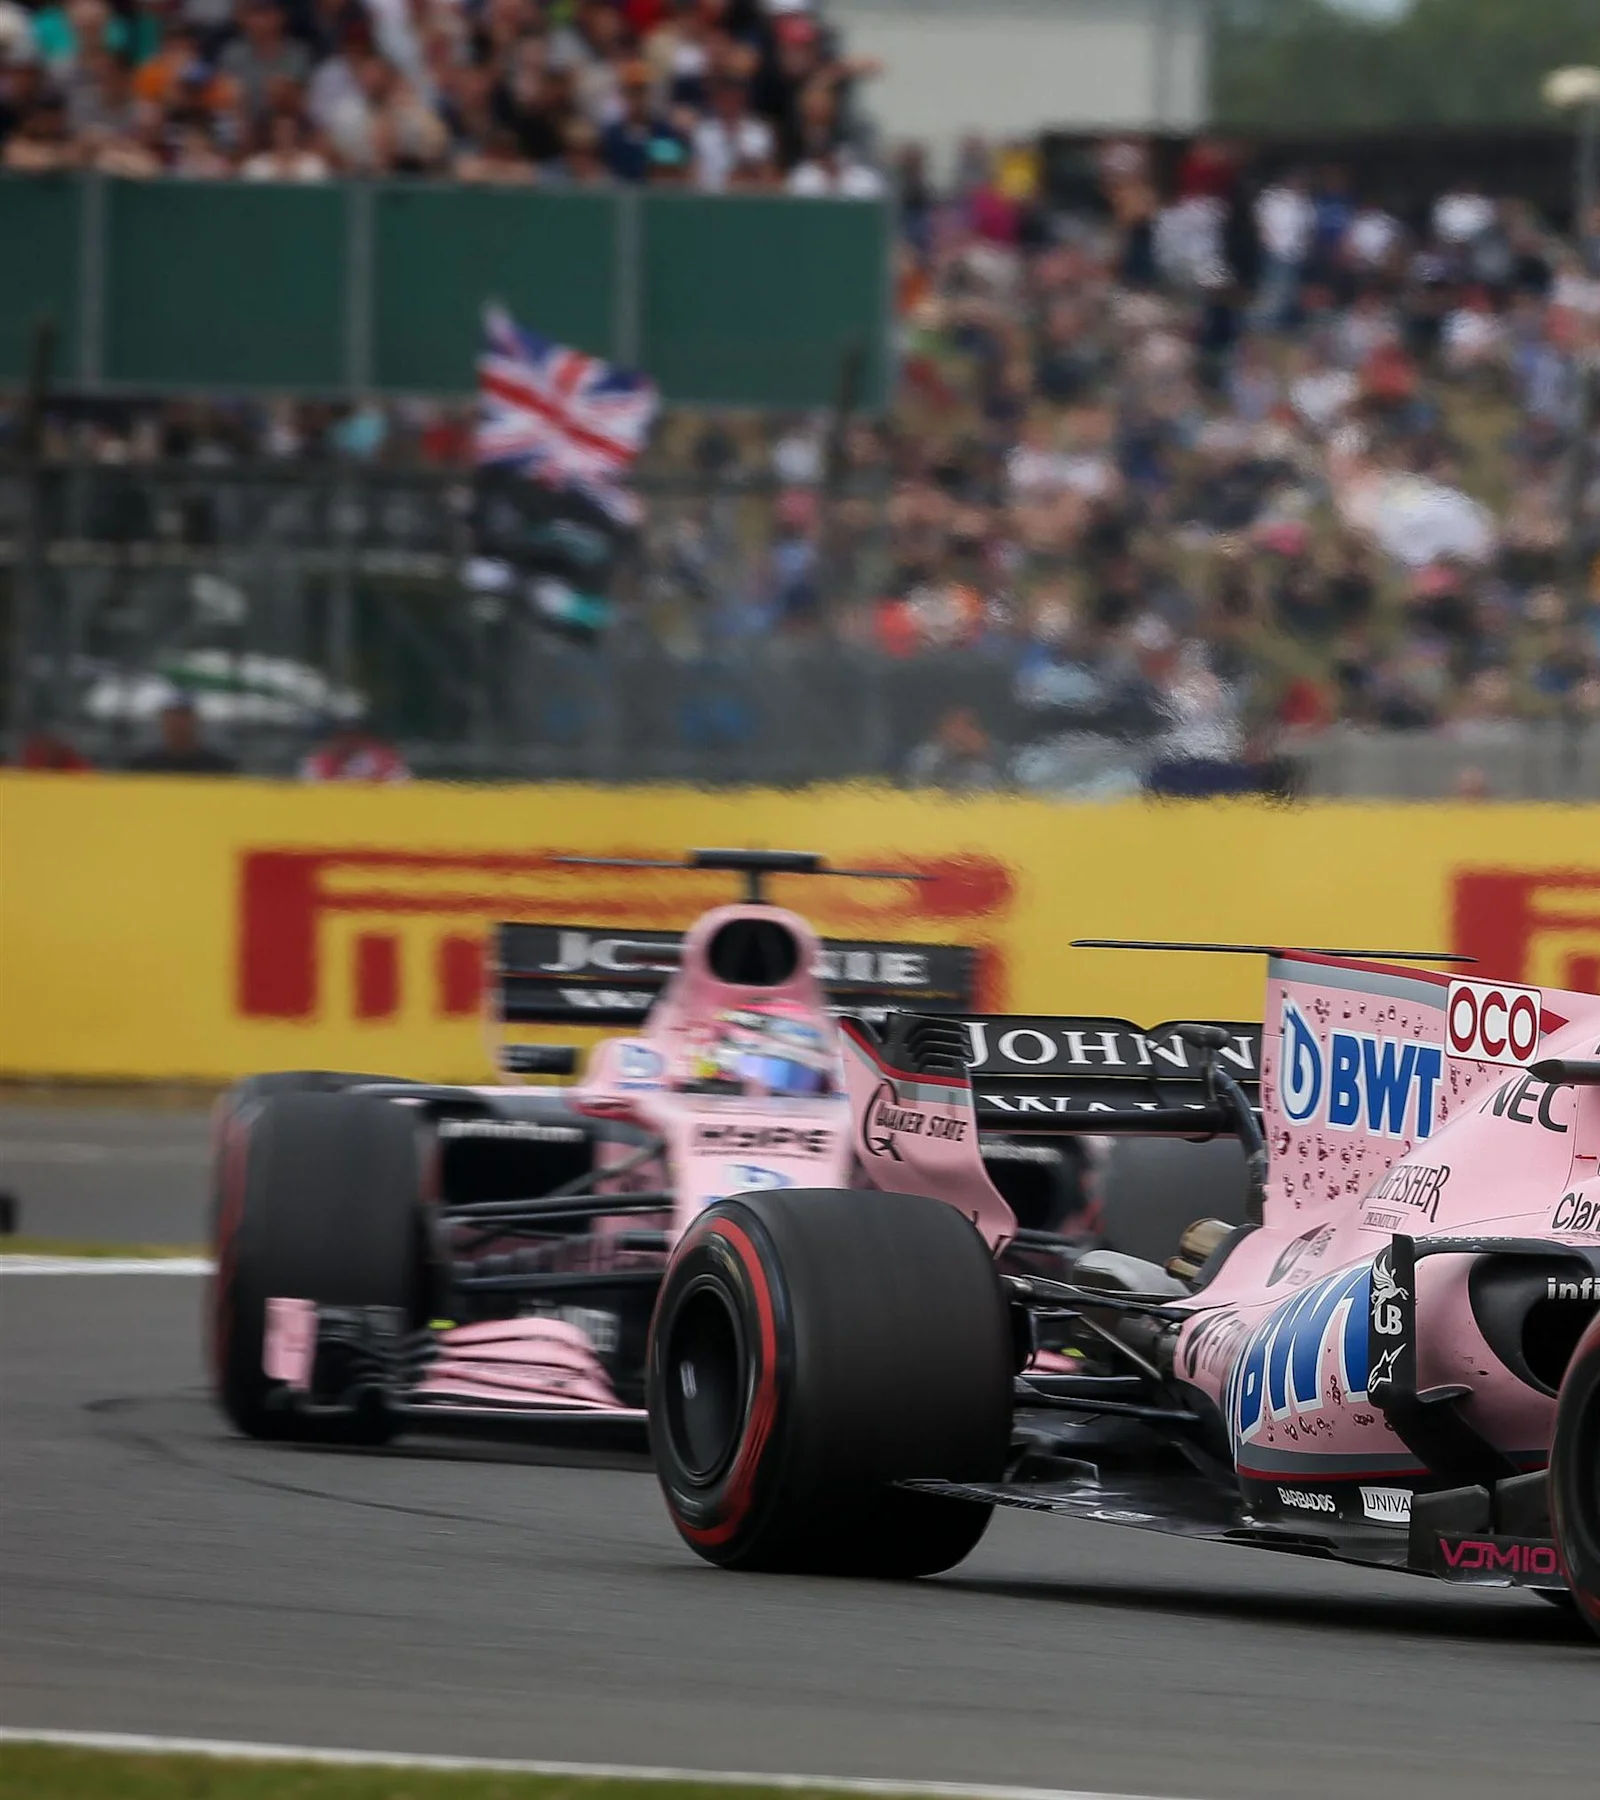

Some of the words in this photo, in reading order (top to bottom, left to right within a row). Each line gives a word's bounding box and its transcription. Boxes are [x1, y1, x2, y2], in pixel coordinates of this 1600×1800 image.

[962, 1021, 1255, 1070] JOHNN
[1450, 987, 1537, 1061] OCO
[1329, 1032, 1443, 1140] BWT
[1479, 1075, 1575, 1133] NEC
[1374, 1305, 1403, 1335] UB
[1240, 1265, 1370, 1438] BWT
[1277, 1487, 1336, 1513] BARBADOS
